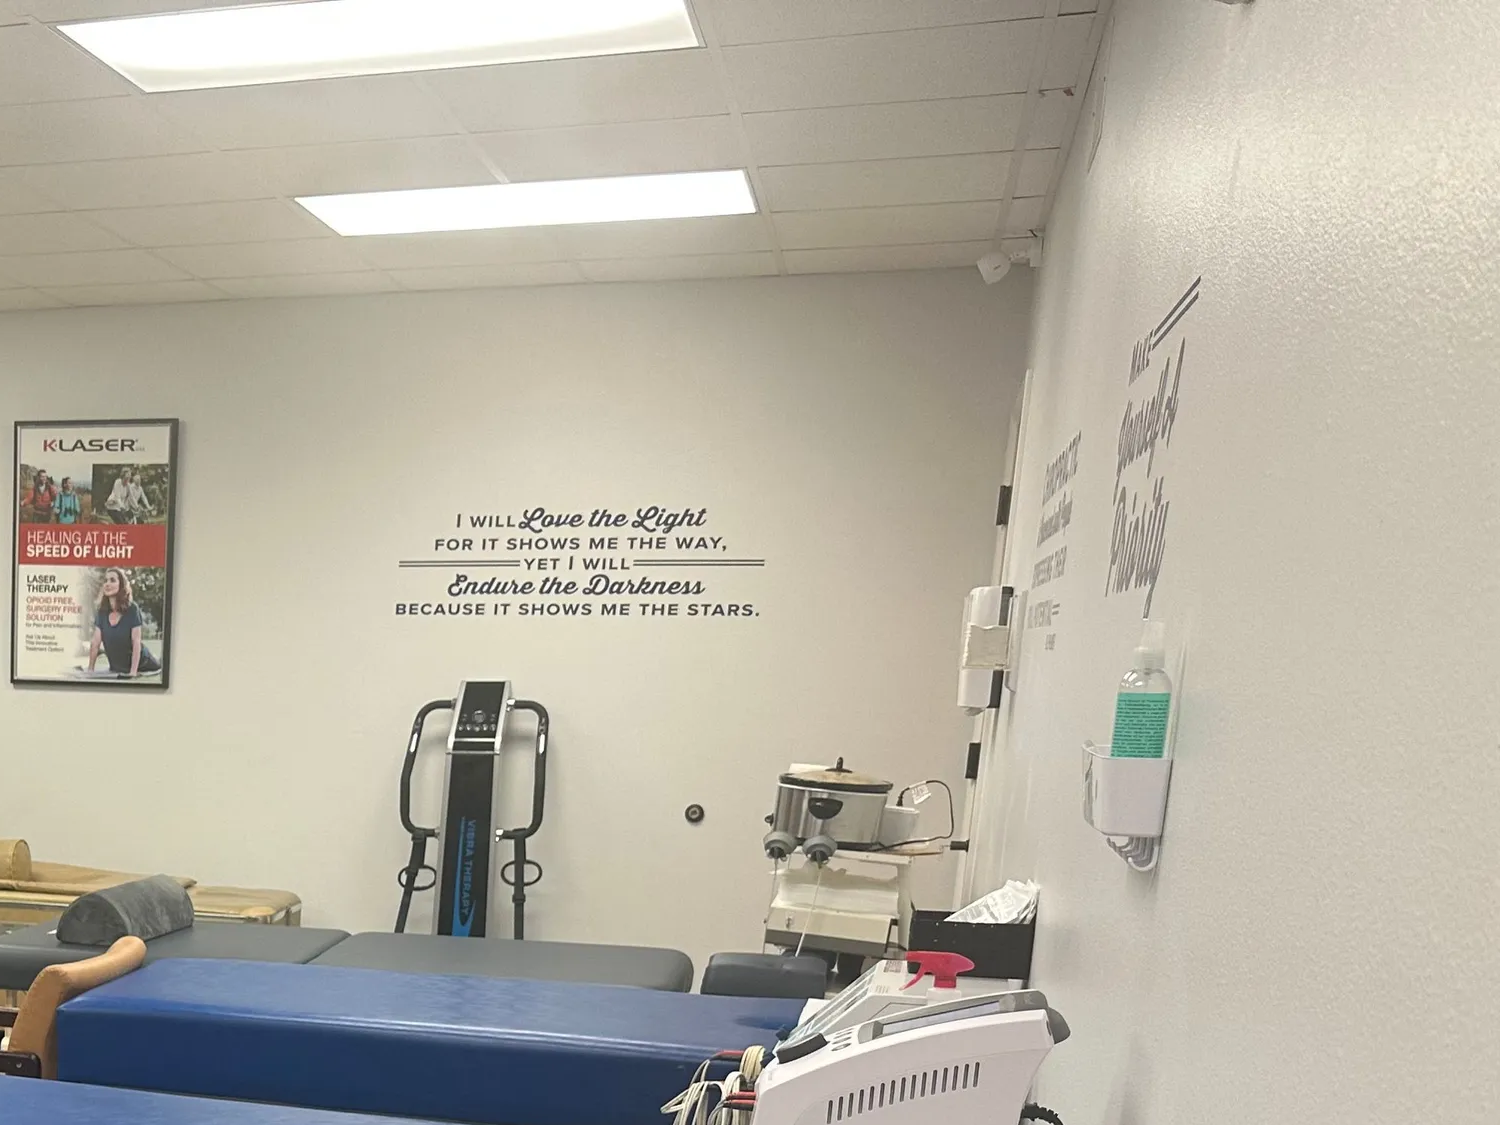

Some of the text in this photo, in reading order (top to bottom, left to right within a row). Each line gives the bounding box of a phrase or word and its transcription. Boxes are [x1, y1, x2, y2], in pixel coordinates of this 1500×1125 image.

[456, 506, 707, 534] I WILL Love the Light
[27, 530, 128, 546] HEALING AT THE
[434, 536, 727, 552] FOR IT SHOWS ME THE WAY,
[26, 544, 134, 559] SPEED OF LIGHT
[1105, 476, 1170, 619] Priority
[524, 555, 631, 571] YET I WILL
[26, 575, 56, 584] LASER
[447, 573, 706, 597] Endure the Darkness
[26, 584, 68, 593] THERAPY
[26, 596, 52, 604] OPIOID
[26, 605, 61, 613] SURGERY
[395, 603, 760, 617] BECAUSE IT SHOWS ME THE STARS.
[461, 819, 476, 915] VIBRA THERAPY
